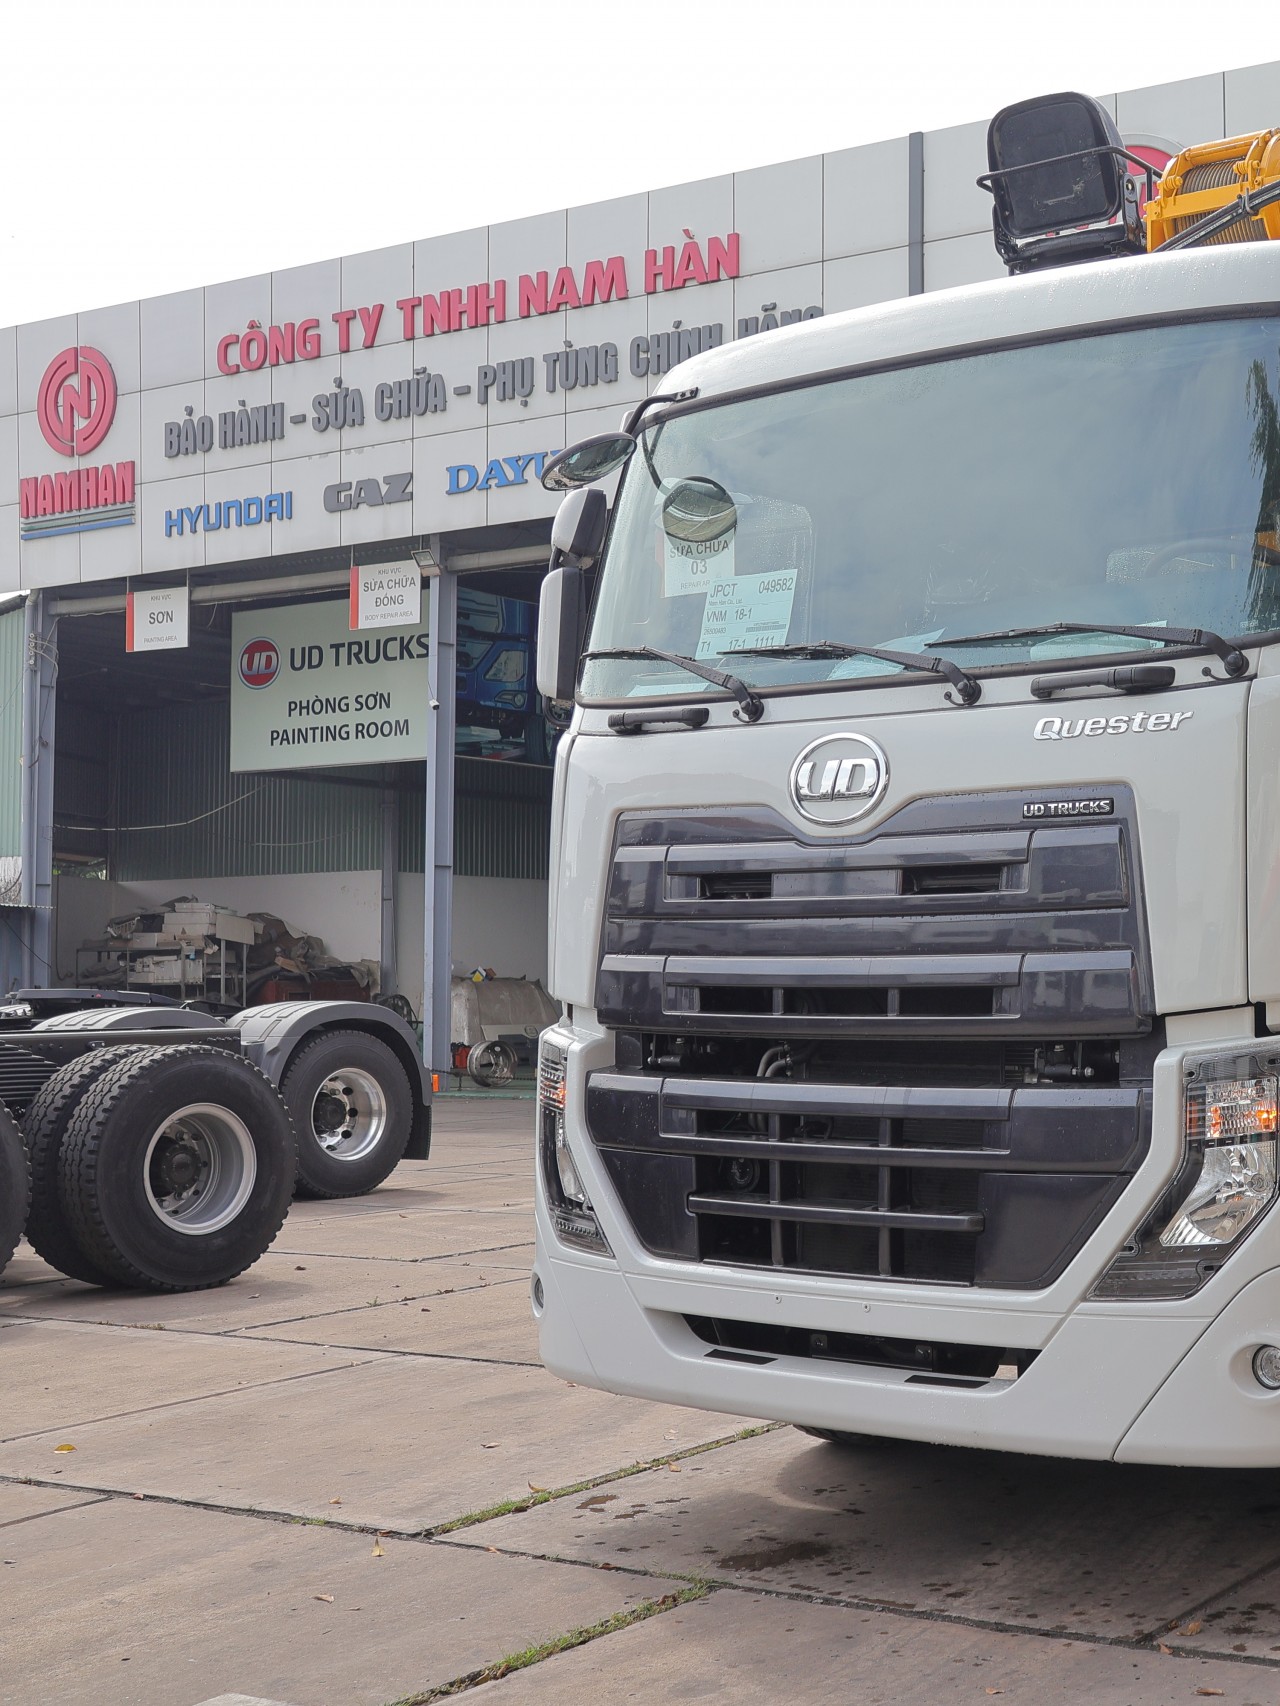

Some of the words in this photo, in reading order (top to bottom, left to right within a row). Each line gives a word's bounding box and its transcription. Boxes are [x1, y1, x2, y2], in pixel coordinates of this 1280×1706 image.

[217, 320, 321, 375] CÔNG
[332, 304, 384, 353] TY
[396, 279, 507, 341] TNHH
[518, 256, 630, 319] NAM
[645, 229, 740, 294] HÀN
[165, 405, 214, 458] BẢO
[218, 399, 285, 449] HÀNH
[312, 376, 365, 432] SỬA
[375, 366, 447, 421] CHỮA
[478, 356, 536, 407] PHỤ
[543, 340, 619, 392] TÙNG
[20, 460, 136, 519] NAMHAN
[323, 472, 413, 513] GAZ
[165, 491, 293, 537] HYUNDAI
[691, 559, 707, 575] 03
[363, 578, 384, 592] SỬA
[387, 575, 416, 590] CHỮA
[710, 583, 738, 598] JPCT
[758, 577, 793, 594] 049582
[149, 610, 173, 624] SƠN
[706, 610, 727, 622] VNM
[735, 608, 752, 620] 18-1
[241, 651, 277, 676] UD
[290, 645, 323, 671] UD
[330, 633, 429, 667] TRUCKS
[288, 695, 350, 717] PHÒNG
[354, 691, 391, 712] SƠN
[270, 723, 350, 746] PAINTING
[355, 719, 409, 739] ROOM
[1033, 710, 1194, 741] Quester
[796, 757, 879, 801] UD
[1023, 803, 1045, 817] UD
[1048, 800, 1110, 815] TRUCKS
